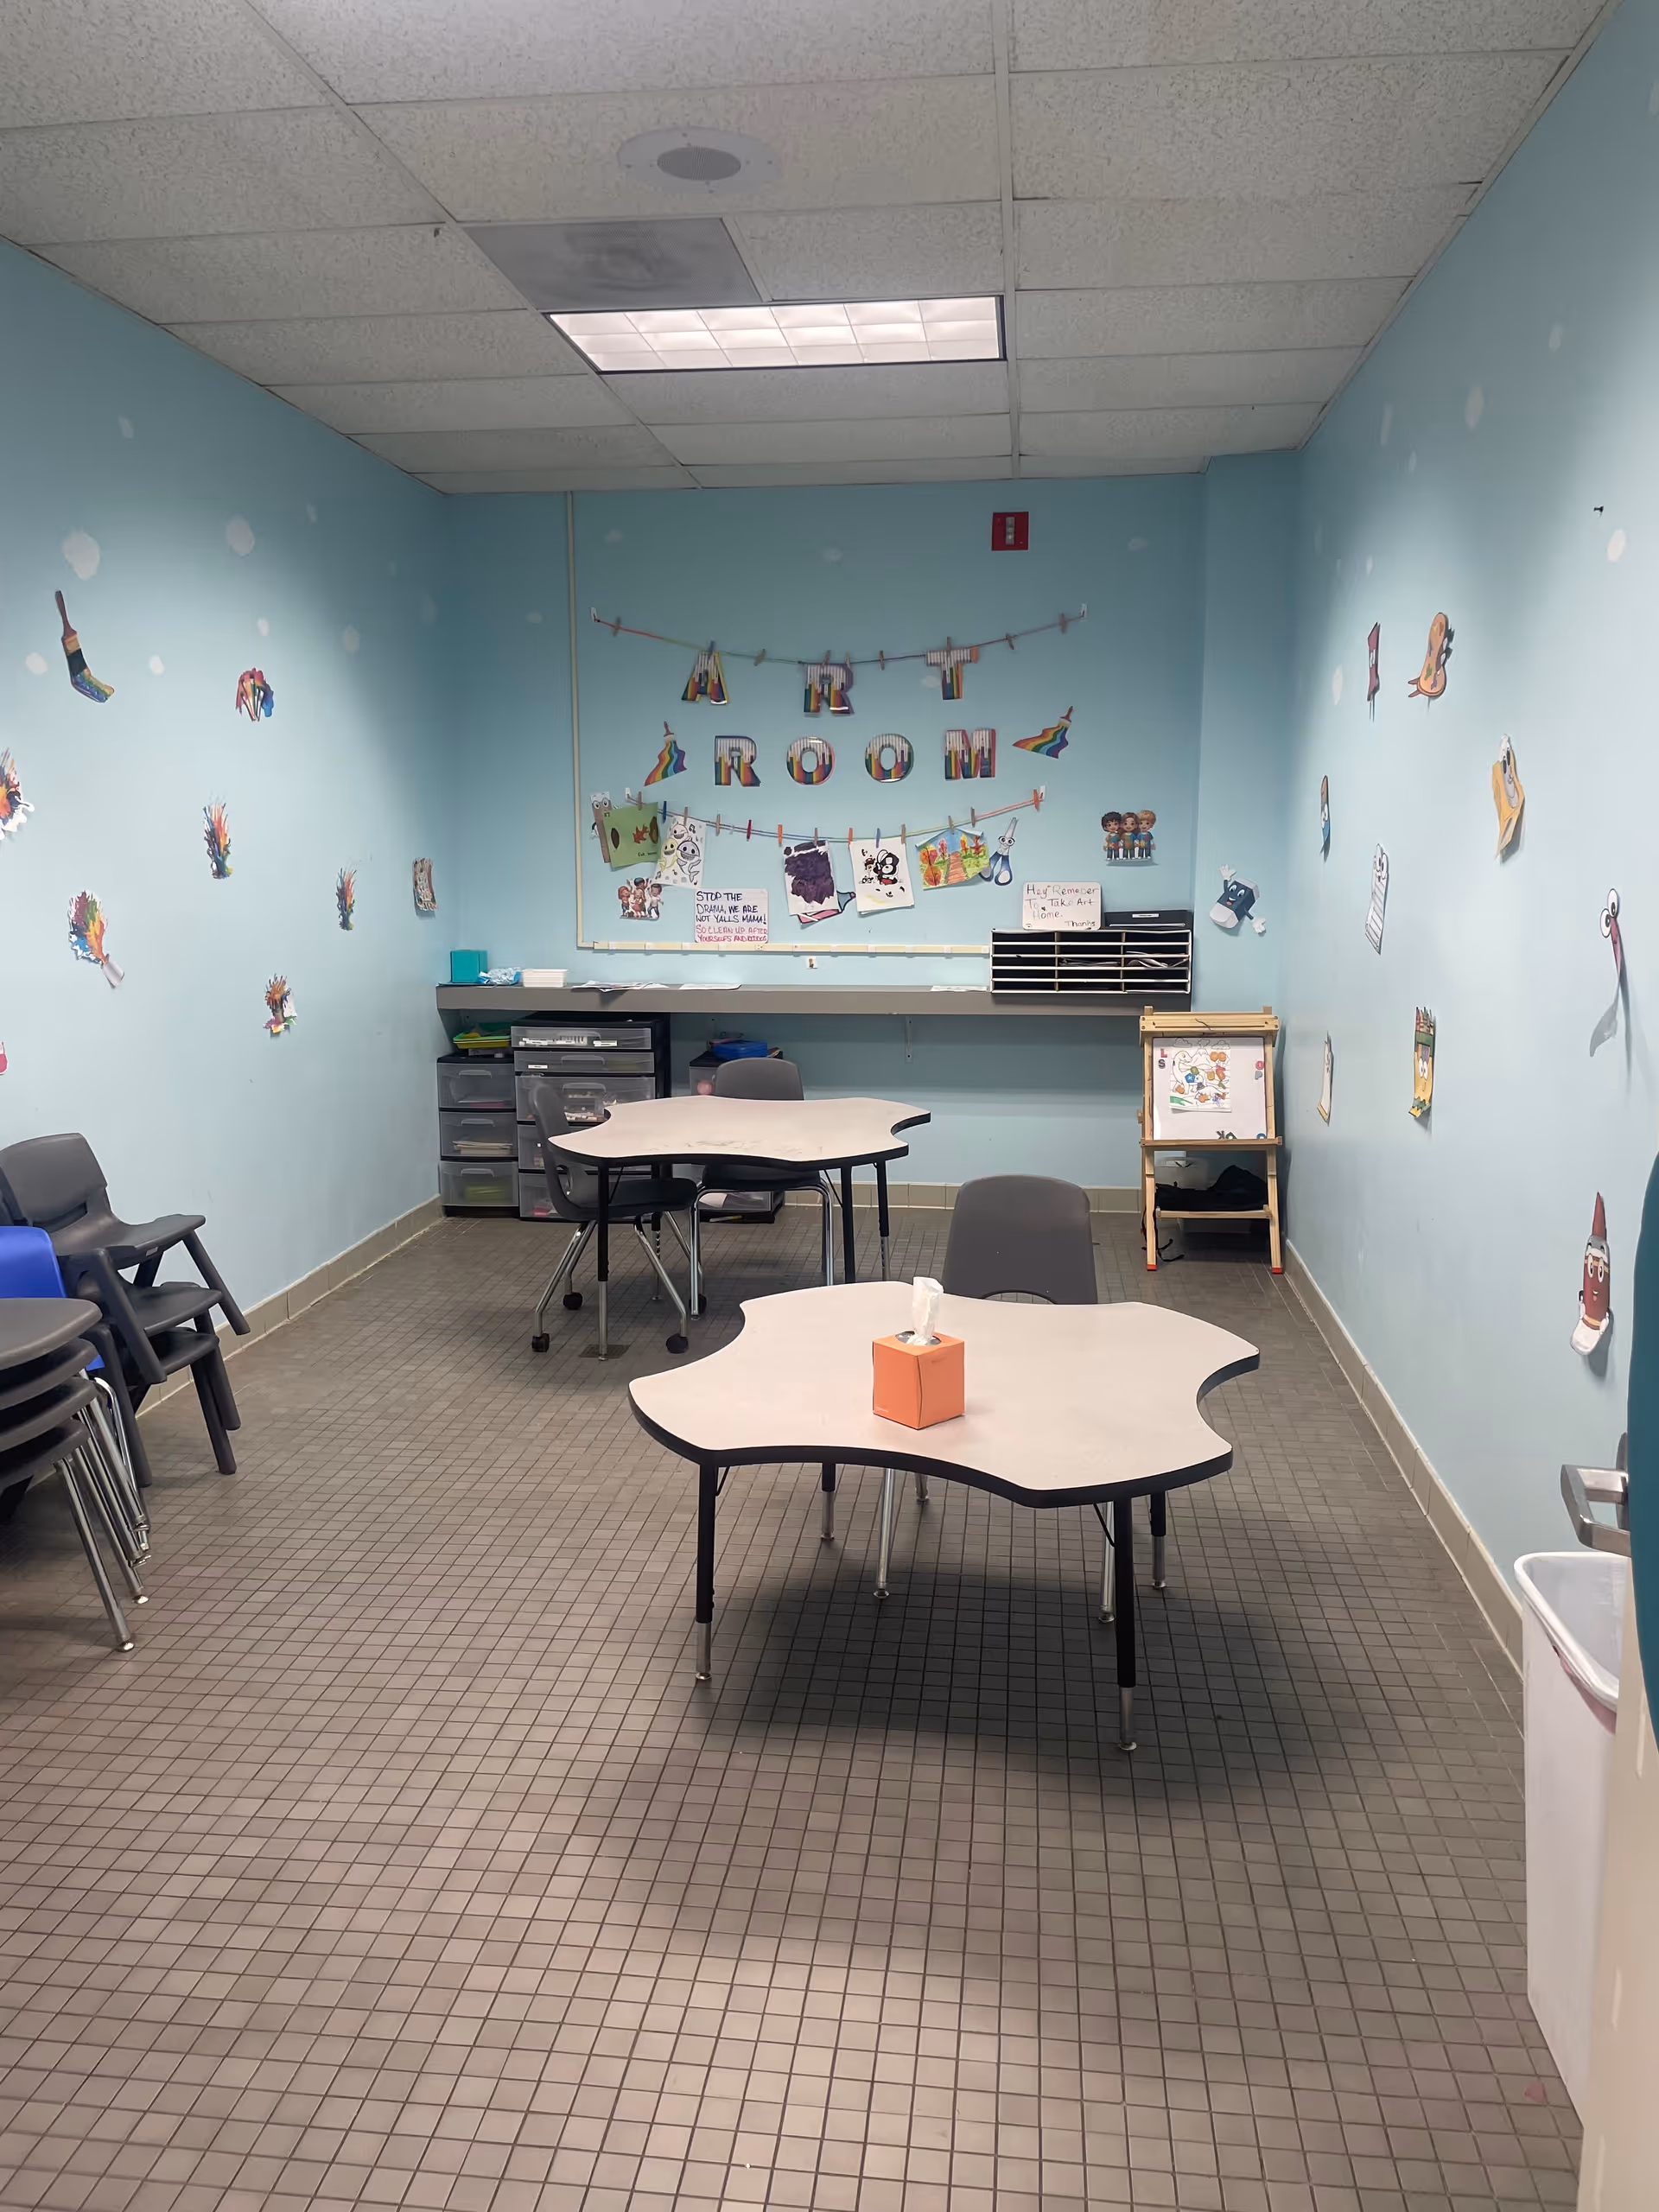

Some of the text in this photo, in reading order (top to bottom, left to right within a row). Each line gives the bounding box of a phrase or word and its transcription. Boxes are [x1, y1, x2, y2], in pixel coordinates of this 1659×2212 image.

[681, 649, 978, 715] ART
[714, 728, 996, 786] ROOM
[696, 891, 742, 902] STOP THE
[696, 904, 727, 914] DRAMA,
[728, 906, 740, 914] WE
[1025, 899, 1039, 909] To
[742, 913, 766, 925] MAMA!
[696, 925, 706, 934] SO
